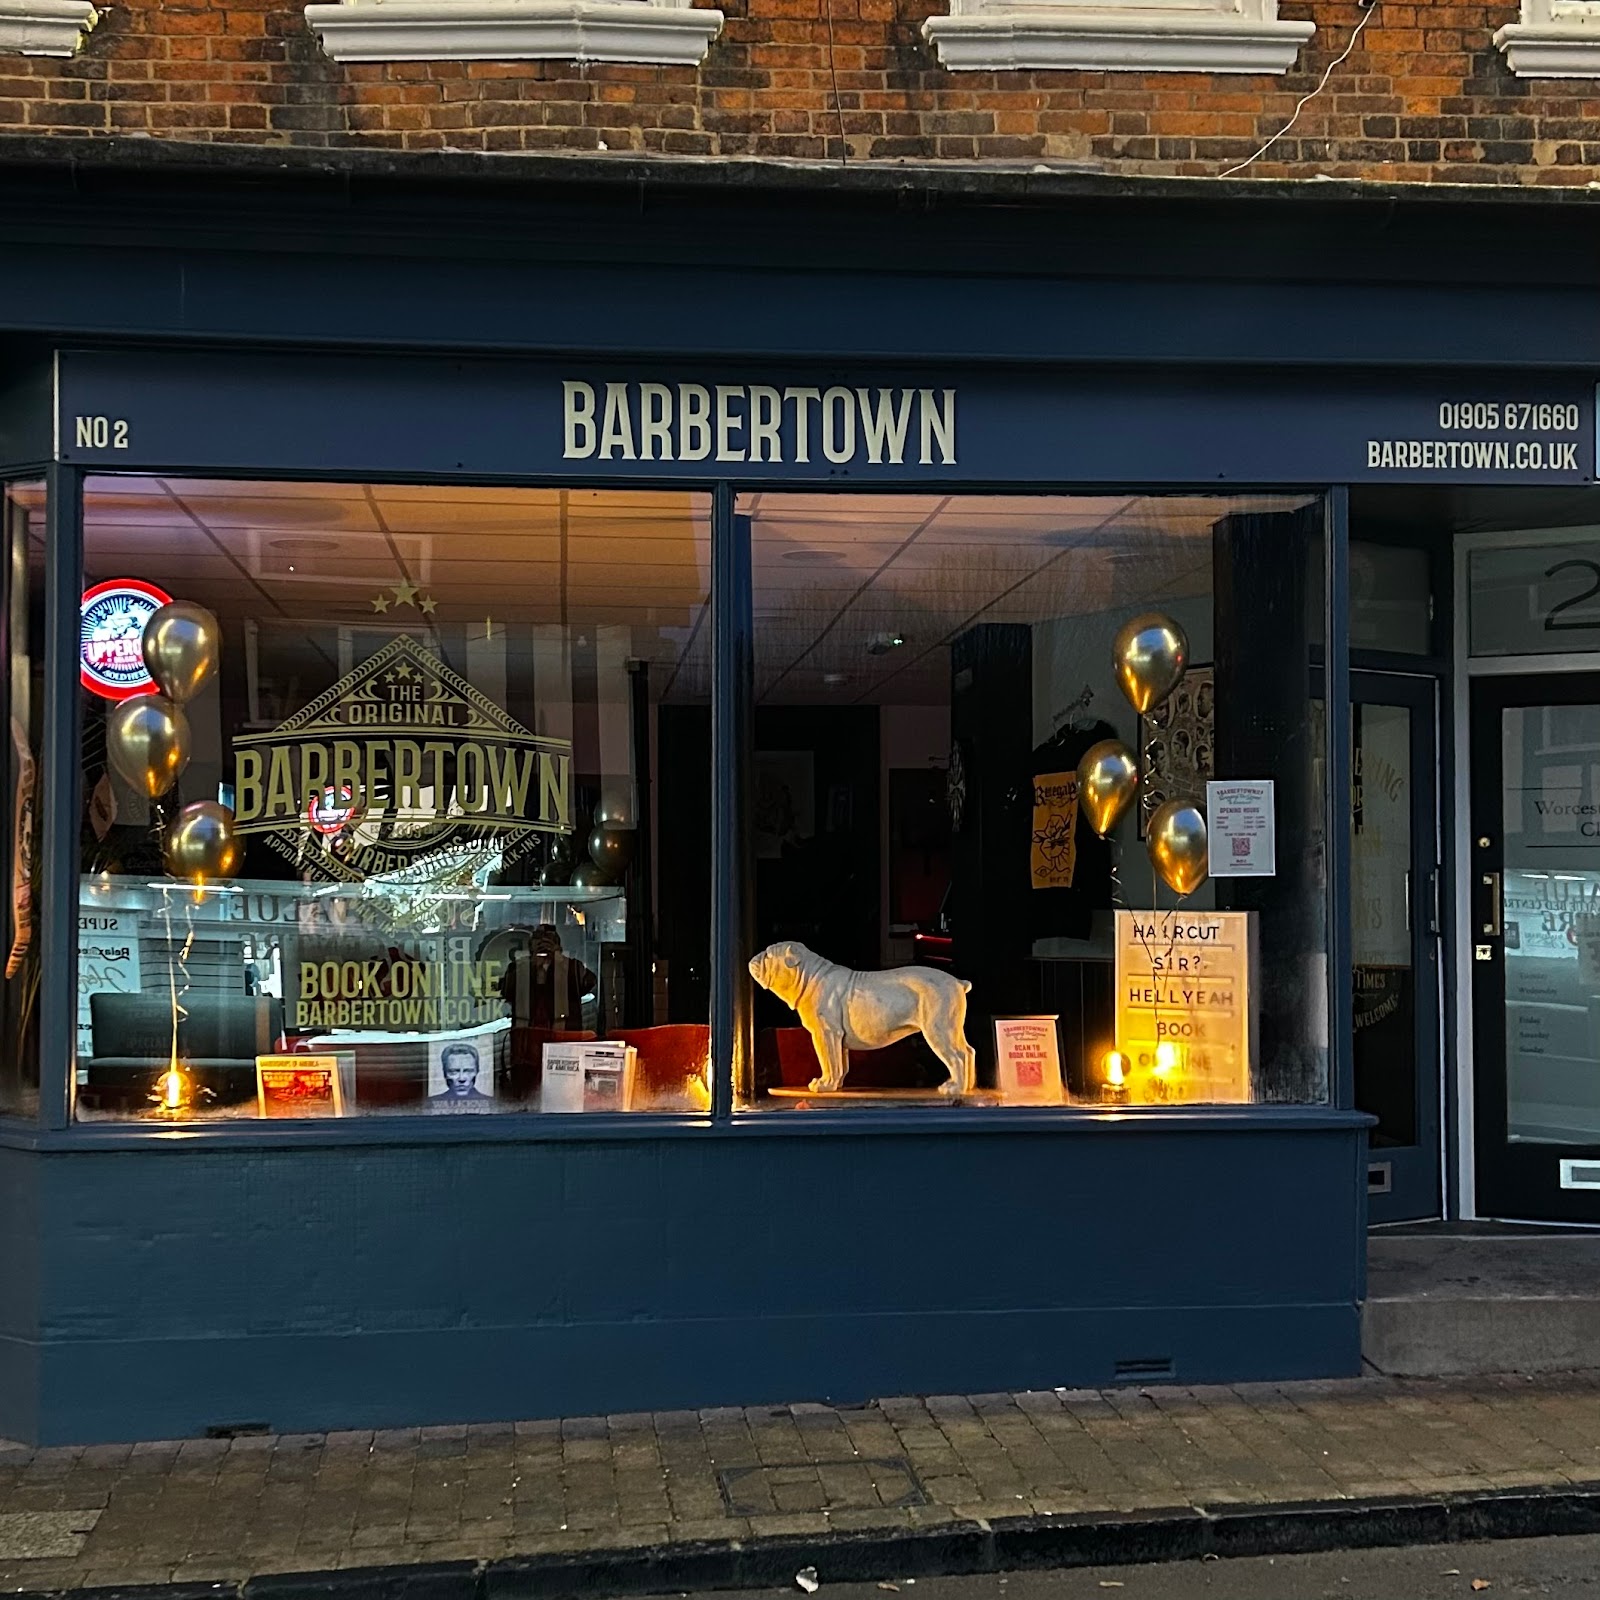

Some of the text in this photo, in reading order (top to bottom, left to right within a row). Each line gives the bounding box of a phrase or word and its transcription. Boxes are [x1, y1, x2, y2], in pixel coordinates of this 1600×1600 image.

[562, 380, 957, 464] BARBERTOWN
[1439, 402, 1579, 430] 01905 671660
[76, 416, 129, 448] NO 2
[1367, 440, 1578, 470] BARBERTOWN.CO.UK
[1545, 559, 1600, 631] 2
[387, 685, 421, 702] THE
[349, 703, 459, 726] ORIGINAL
[233, 739, 571, 825] BARBERTOWN
[1133, 925, 1220, 940] HAIRCUT
[300, 960, 501, 999] BOOK ONLINE
[1355, 970, 1386, 990] TIMES
[295, 1000, 504, 1026] BARBERTOWN.CO.UK
[1354, 994, 1397, 1029] WELCOME
[1157, 1022, 1206, 1037] BOOK
